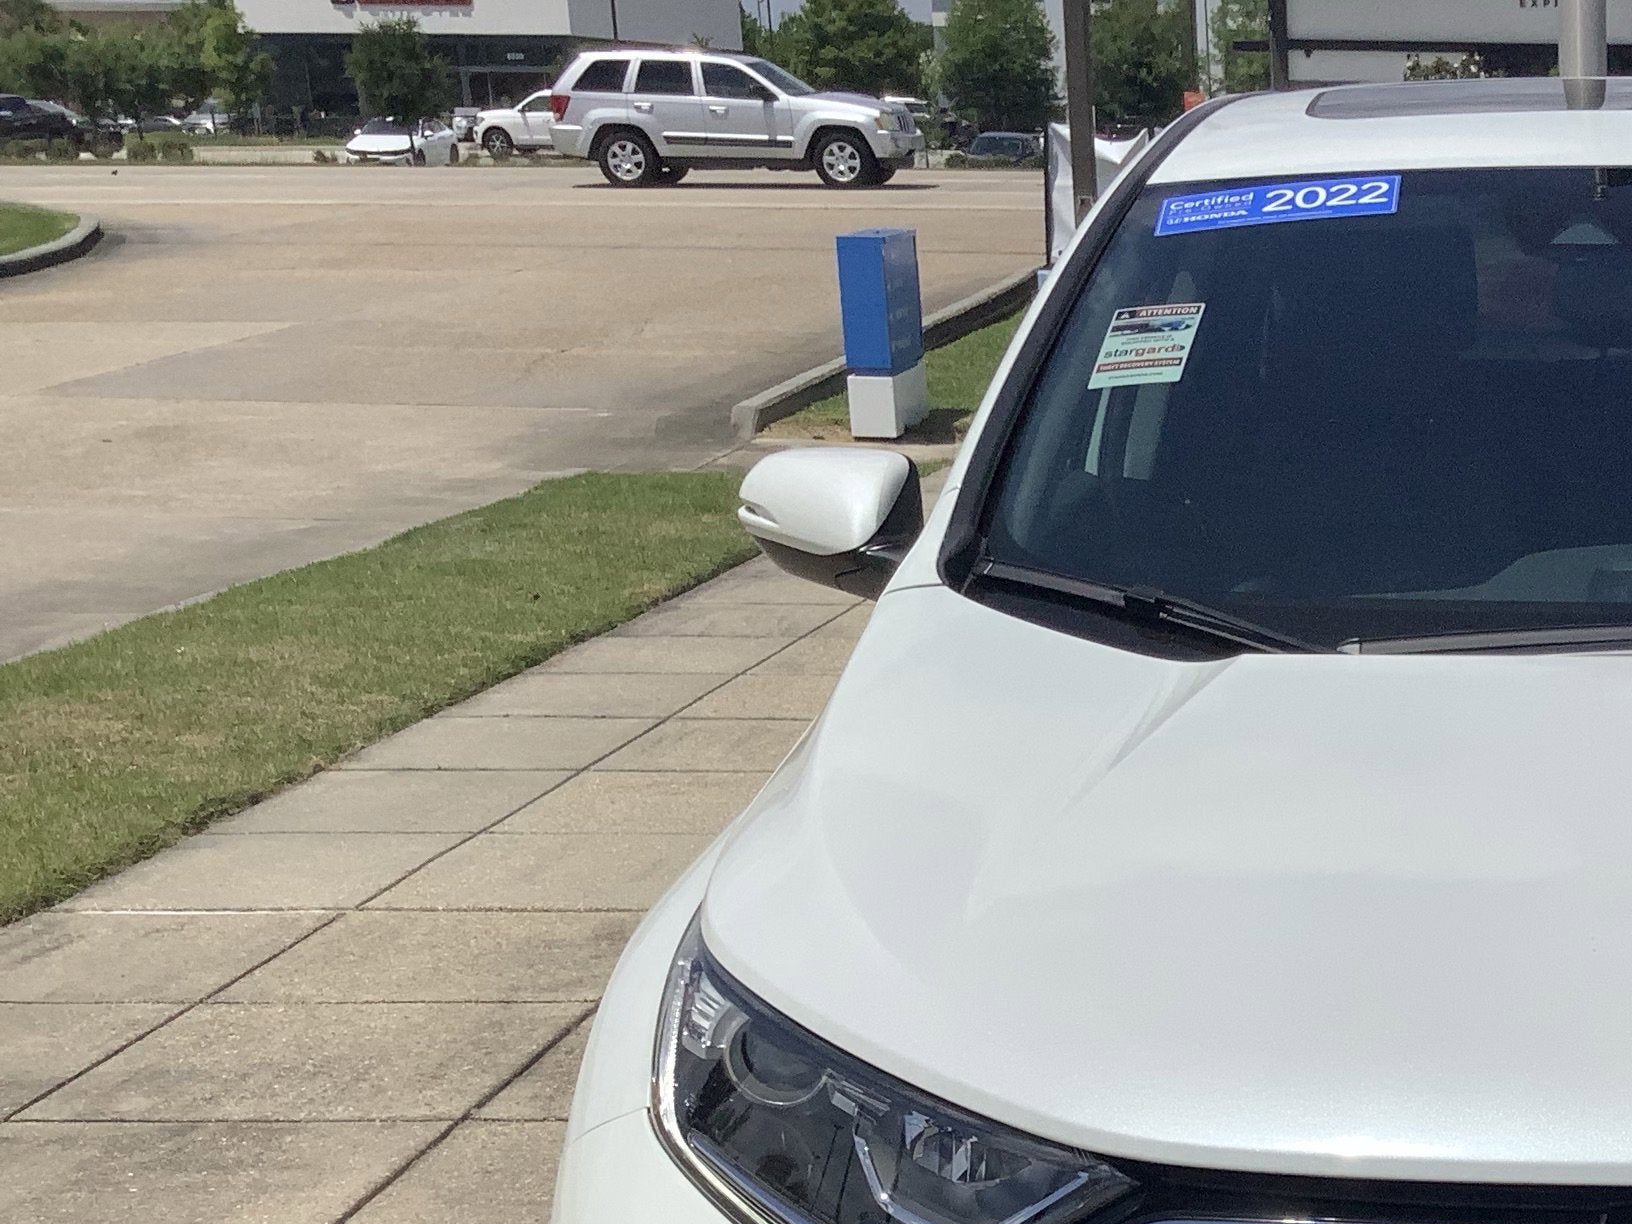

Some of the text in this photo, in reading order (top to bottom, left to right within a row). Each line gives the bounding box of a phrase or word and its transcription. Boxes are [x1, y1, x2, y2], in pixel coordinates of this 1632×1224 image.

[1169, 192, 1254, 210] Certified
[1261, 181, 1390, 212] 2022
[1182, 210, 1249, 221] HONDA
[1139, 306, 1198, 317] ATTENTION
